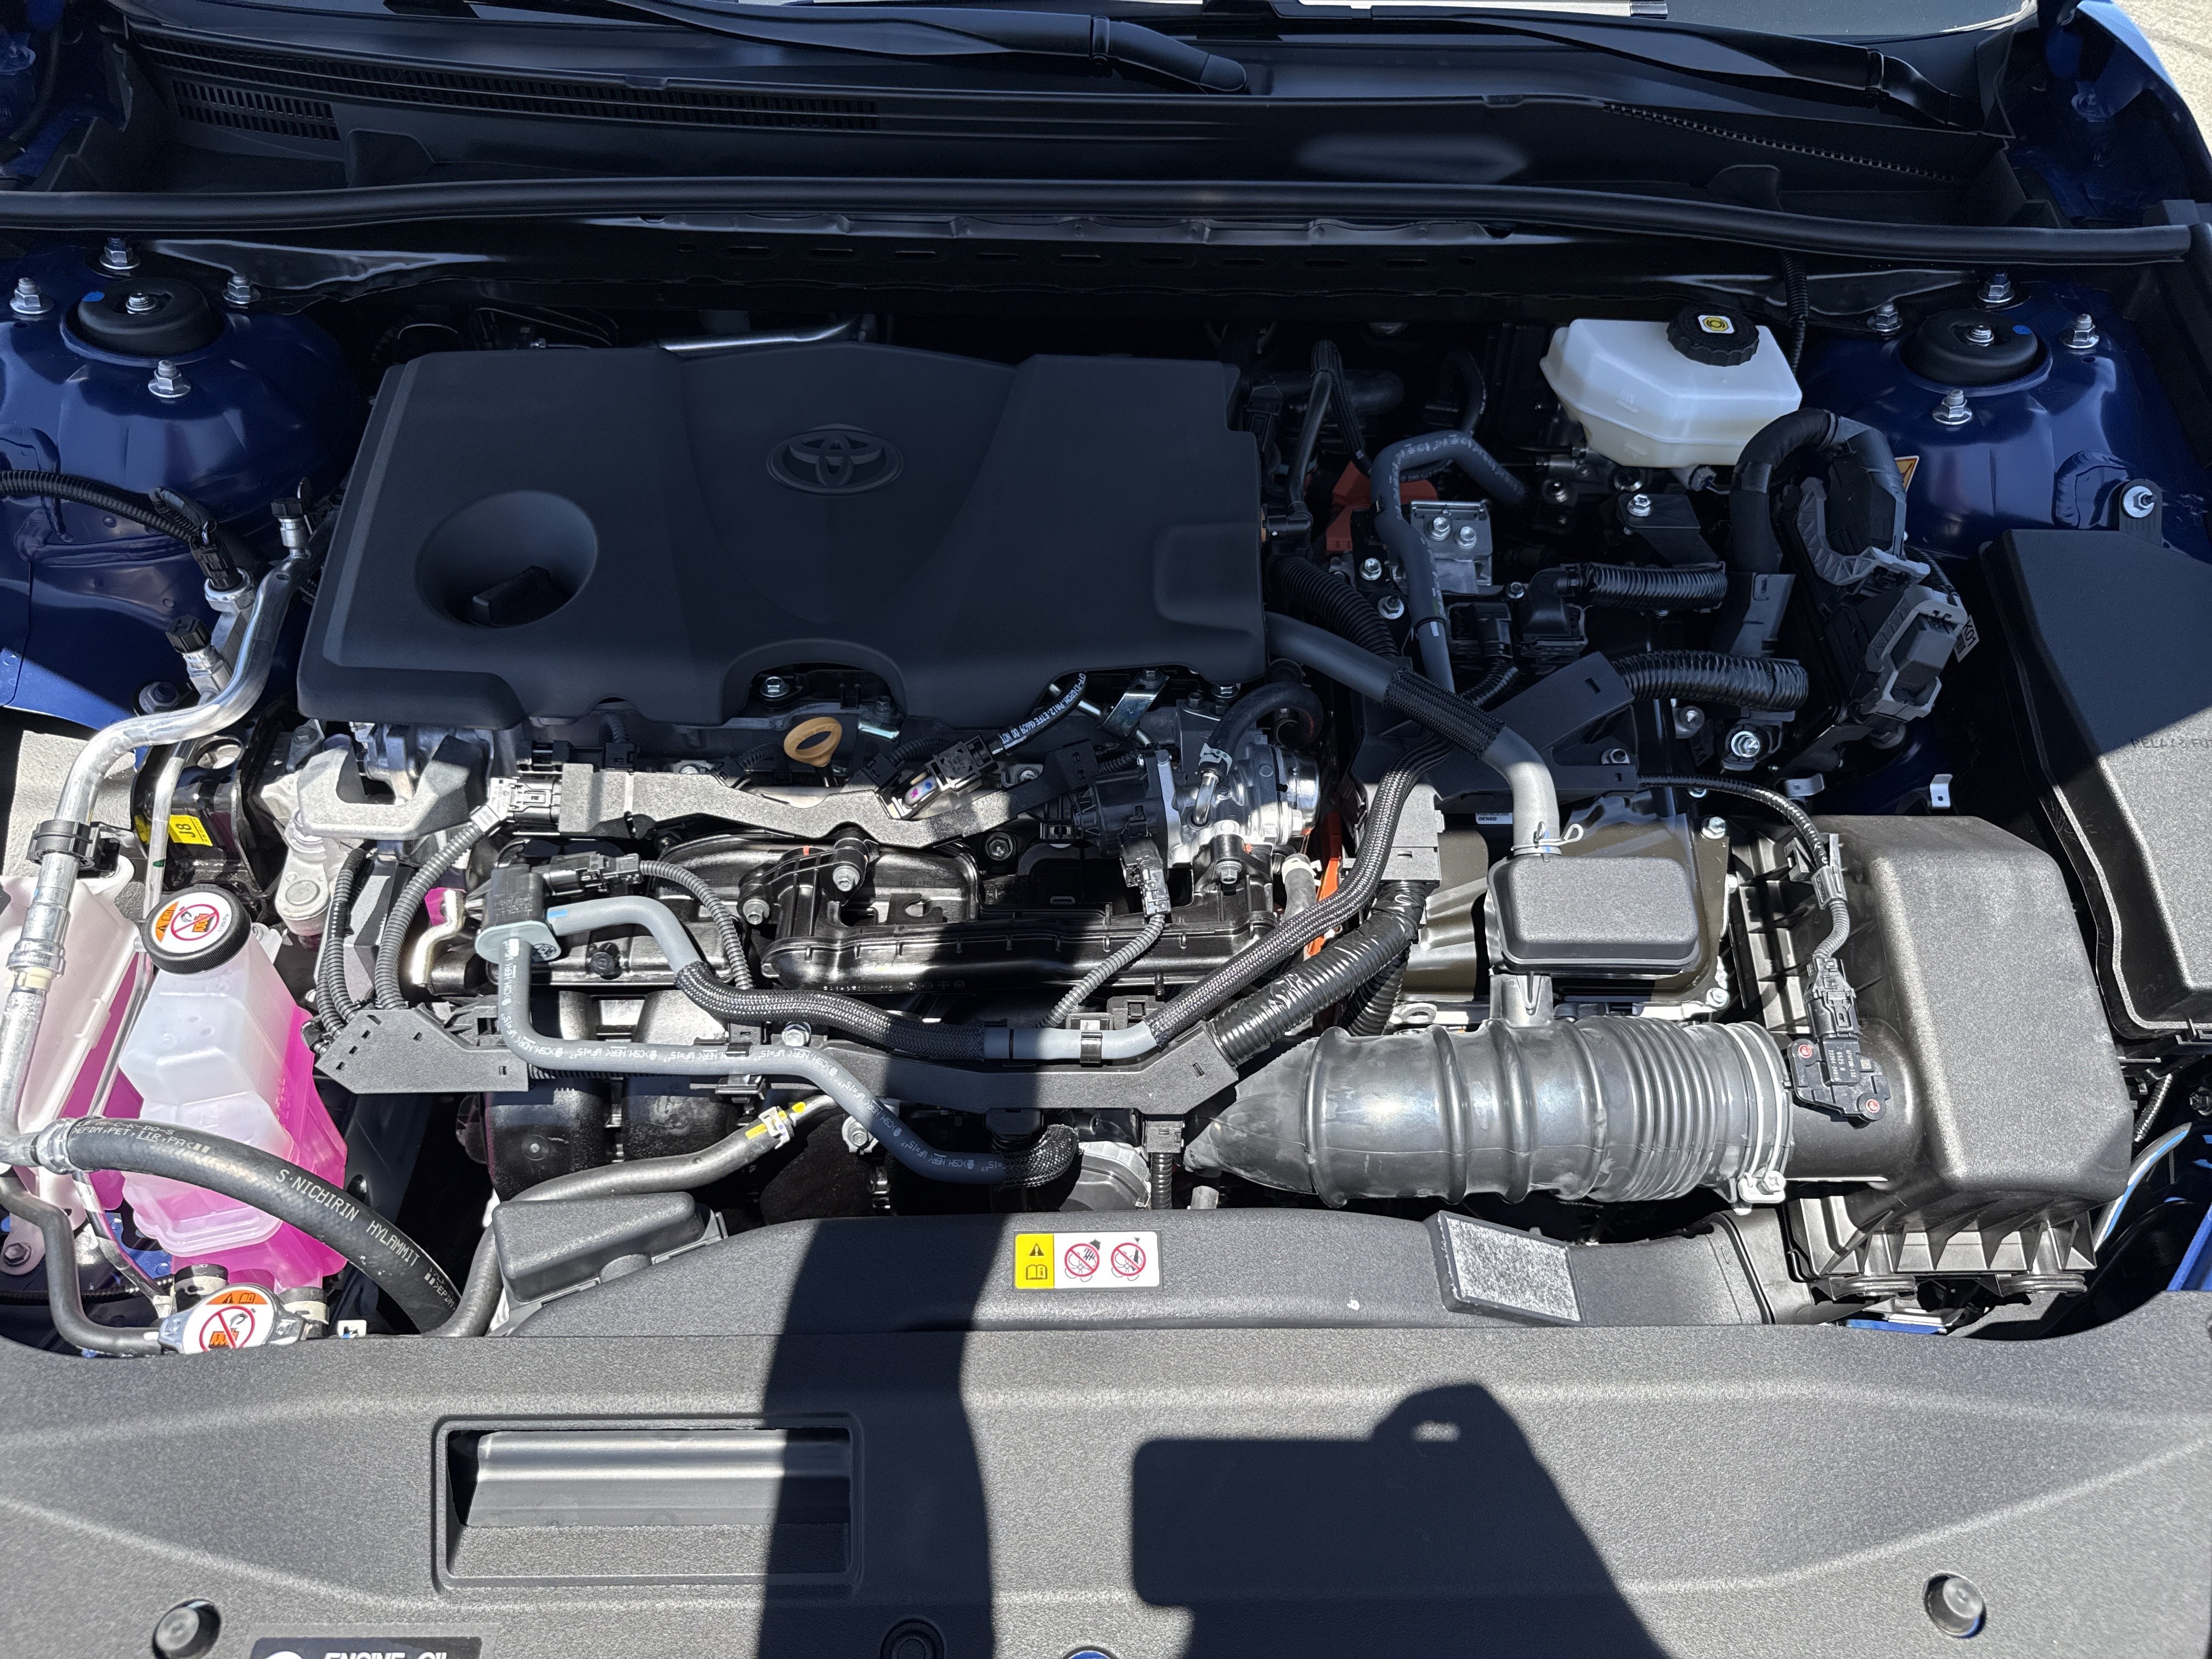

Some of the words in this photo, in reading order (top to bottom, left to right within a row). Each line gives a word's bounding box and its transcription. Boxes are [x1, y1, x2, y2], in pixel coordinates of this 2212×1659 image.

[1962, 620, 1977, 647] K01
[176, 823, 196, 838] J8
[366, 1220, 421, 1267] HYLAMMIT
